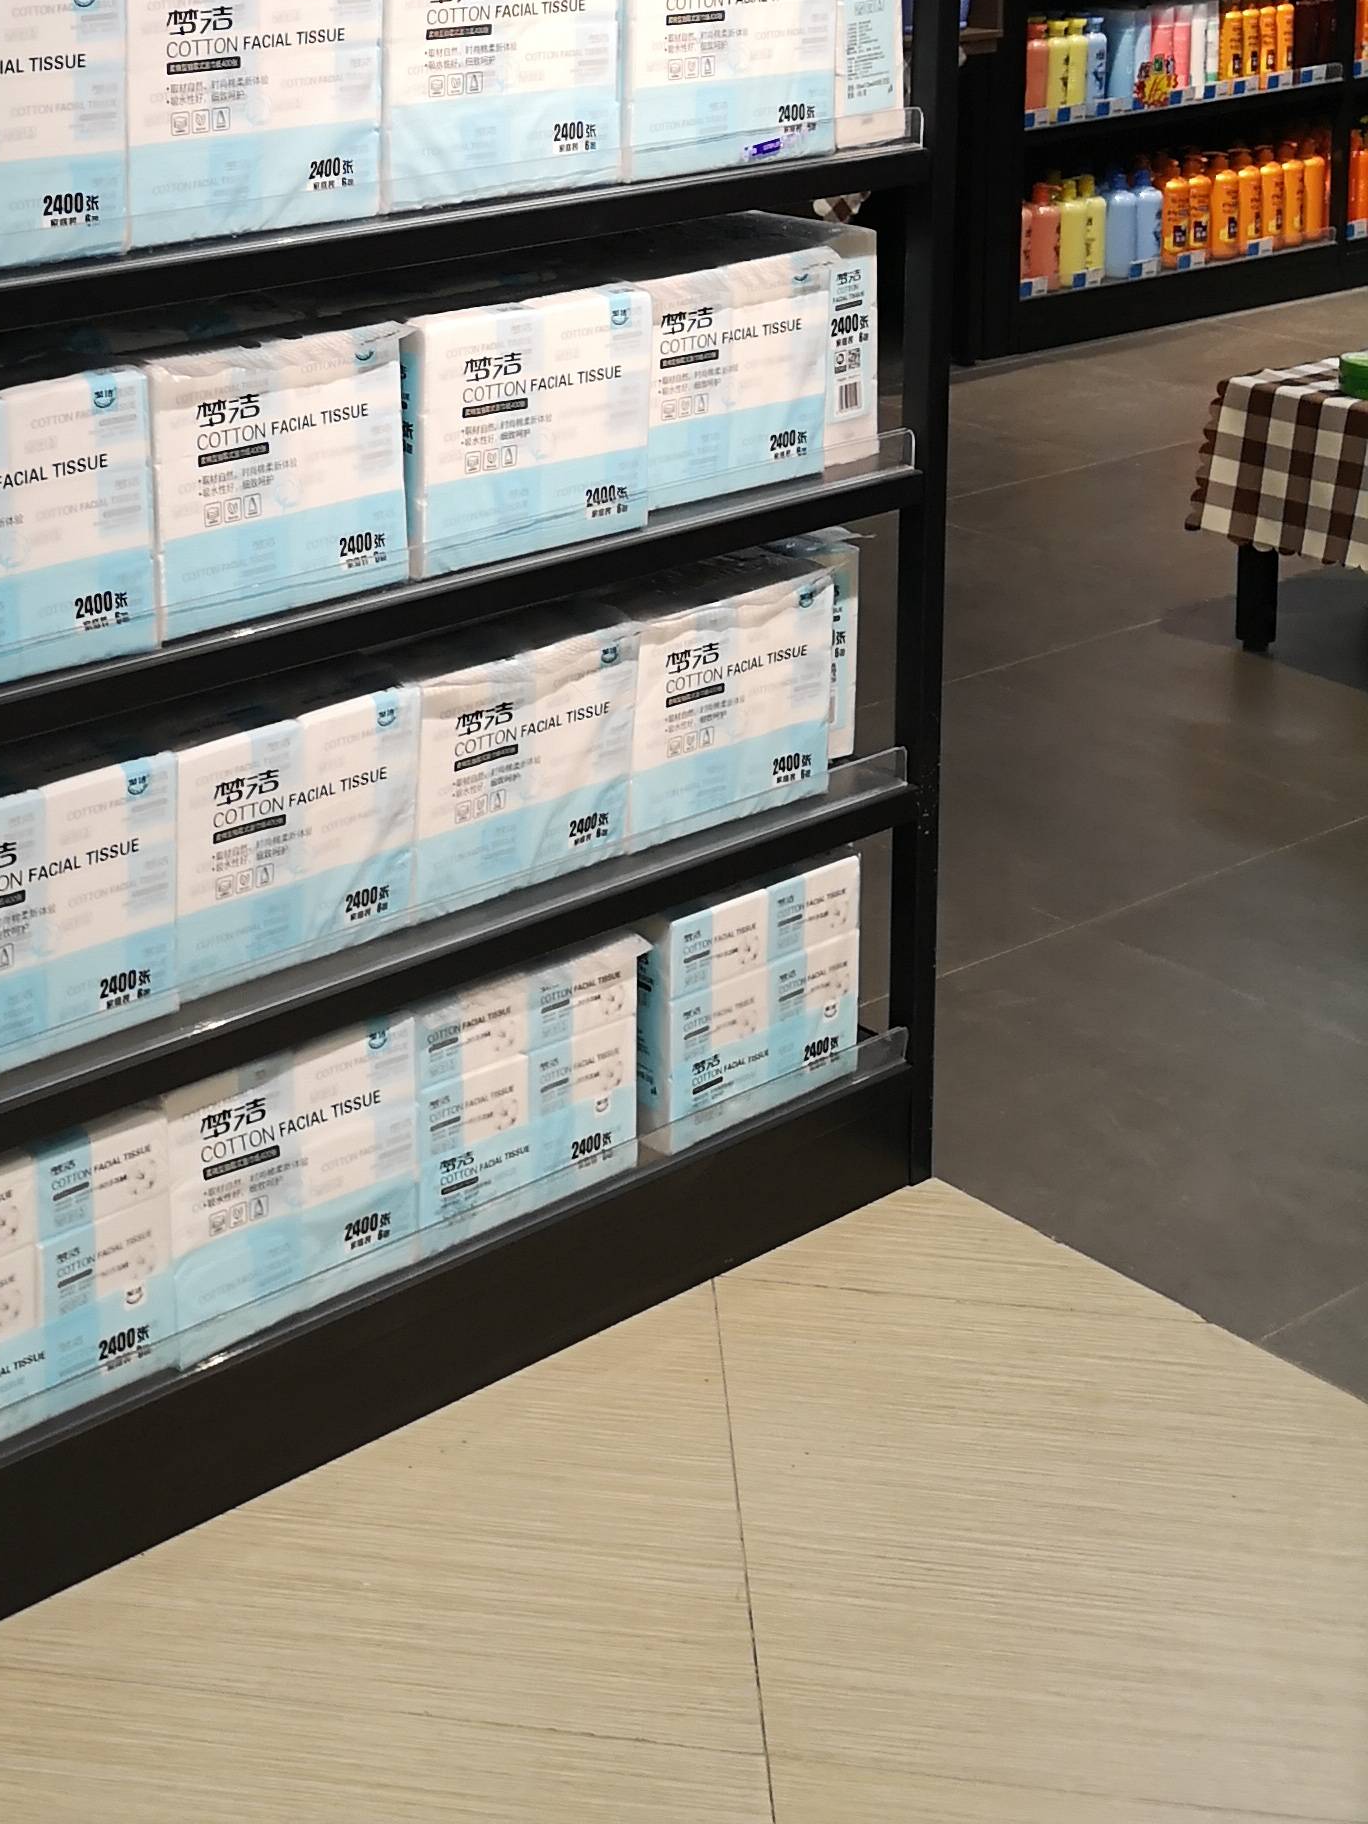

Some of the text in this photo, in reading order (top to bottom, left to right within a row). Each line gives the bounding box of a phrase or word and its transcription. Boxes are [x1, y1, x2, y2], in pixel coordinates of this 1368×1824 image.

[167, 6, 232, 35] 梦洁
[427, 0, 586, 25] COTTON FACIAL TISSUE
[166, 28, 345, 58] COTTON FACIAL TISSUE
[29, 54, 87, 72] TISSUE
[553, 121, 596, 142] 2400张
[309, 157, 354, 180] 2400张
[43, 192, 99, 216] 2400张
[661, 307, 713, 335] 梦洁
[831, 313, 868, 337] 2400张
[660, 318, 802, 356] COTTON FACIAL TISSUE
[464, 352, 522, 382] 梦洁
[463, 365, 622, 403] COTTON FACIAL TISSUE
[196, 394, 260, 427] 梦洁
[197, 403, 369, 451] COTTON FACIAL TISSUE
[770, 430, 807, 451] 2400张
[53, 454, 109, 477] TISSUE
[339, 532, 386, 557] 2400张
[75, 590, 128, 619] 2400张
[666, 642, 719, 675] 梦洁
[666, 645, 808, 694] COTTON FACIAL TISSUE
[455, 702, 610, 758] COTTON FACIAL TISSUE
[456, 702, 514, 737] 梦洁
[773, 753, 811, 776] 2400张
[213, 766, 388, 828] COTTON FACIAL TISSUE
[214, 769, 280, 806] 梦洁
[28, 854, 82, 883] FACIAL
[87, 838, 140, 866] TISSUE
[100, 969, 151, 1000] 2400张
[200, 1098, 266, 1140] 梦洁
[201, 1090, 382, 1162] COTTON FACIAL TISSUE
